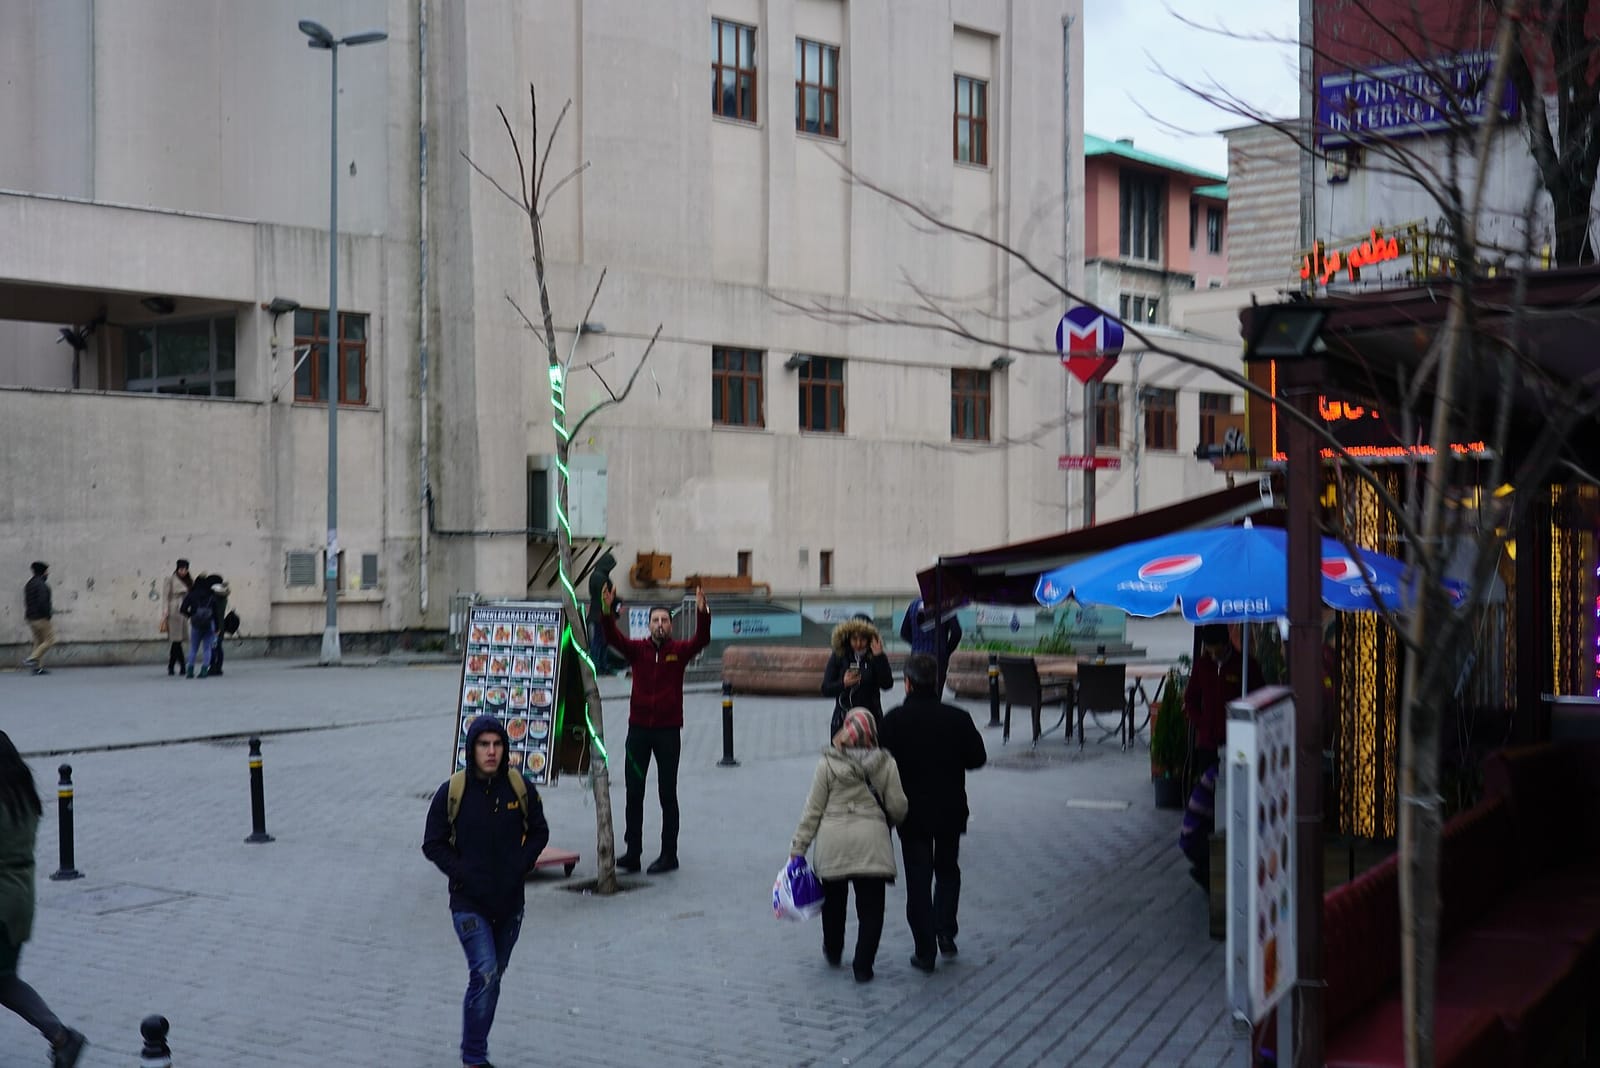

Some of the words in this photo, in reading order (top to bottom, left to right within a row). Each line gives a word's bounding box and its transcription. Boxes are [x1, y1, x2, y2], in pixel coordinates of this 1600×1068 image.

[1300, 240, 1341, 286] مراد
[1347, 227, 1399, 283] مطعم
[1062, 315, 1105, 363] M
[1221, 596, 1271, 616] pepsi
